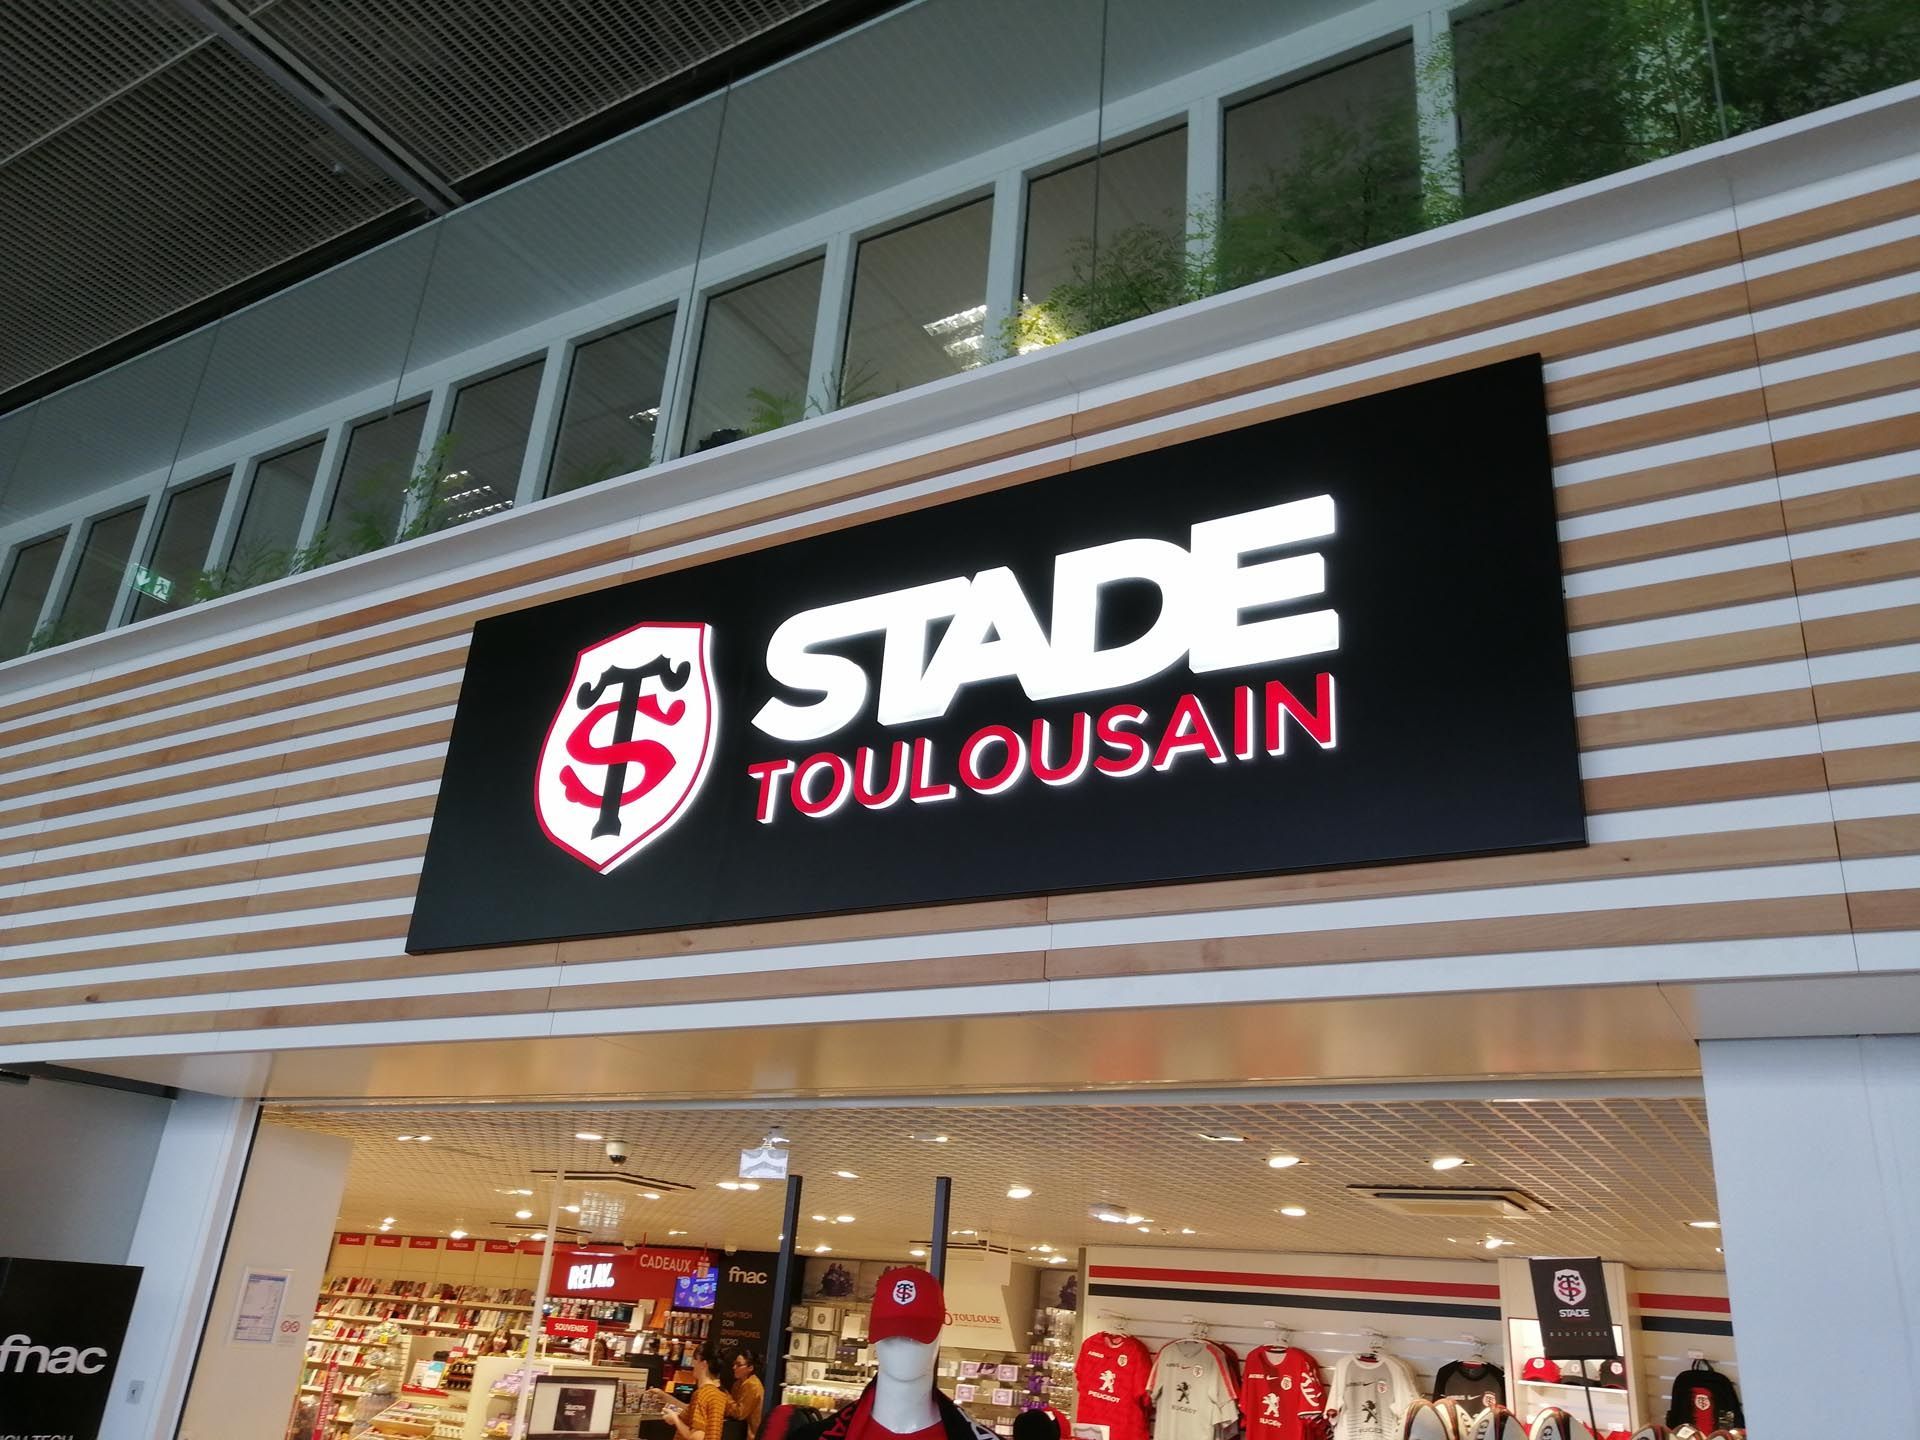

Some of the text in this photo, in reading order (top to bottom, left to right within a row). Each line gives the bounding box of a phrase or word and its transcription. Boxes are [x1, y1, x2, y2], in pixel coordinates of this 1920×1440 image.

[752, 493, 1341, 742] STADE
[747, 672, 1341, 825] TOULOUSAIN
[639, 1254, 692, 1273] CADEAUX
[728, 1266, 768, 1285] fnac
[953, 1313, 1001, 1325] TOULOUSE
[1559, 1309, 1590, 1318] STADE
[554, 1322, 589, 1333] SOUVENIRS
[0, 1333, 108, 1375] fnac
[1087, 1390, 1121, 1404] PEUGEOT
